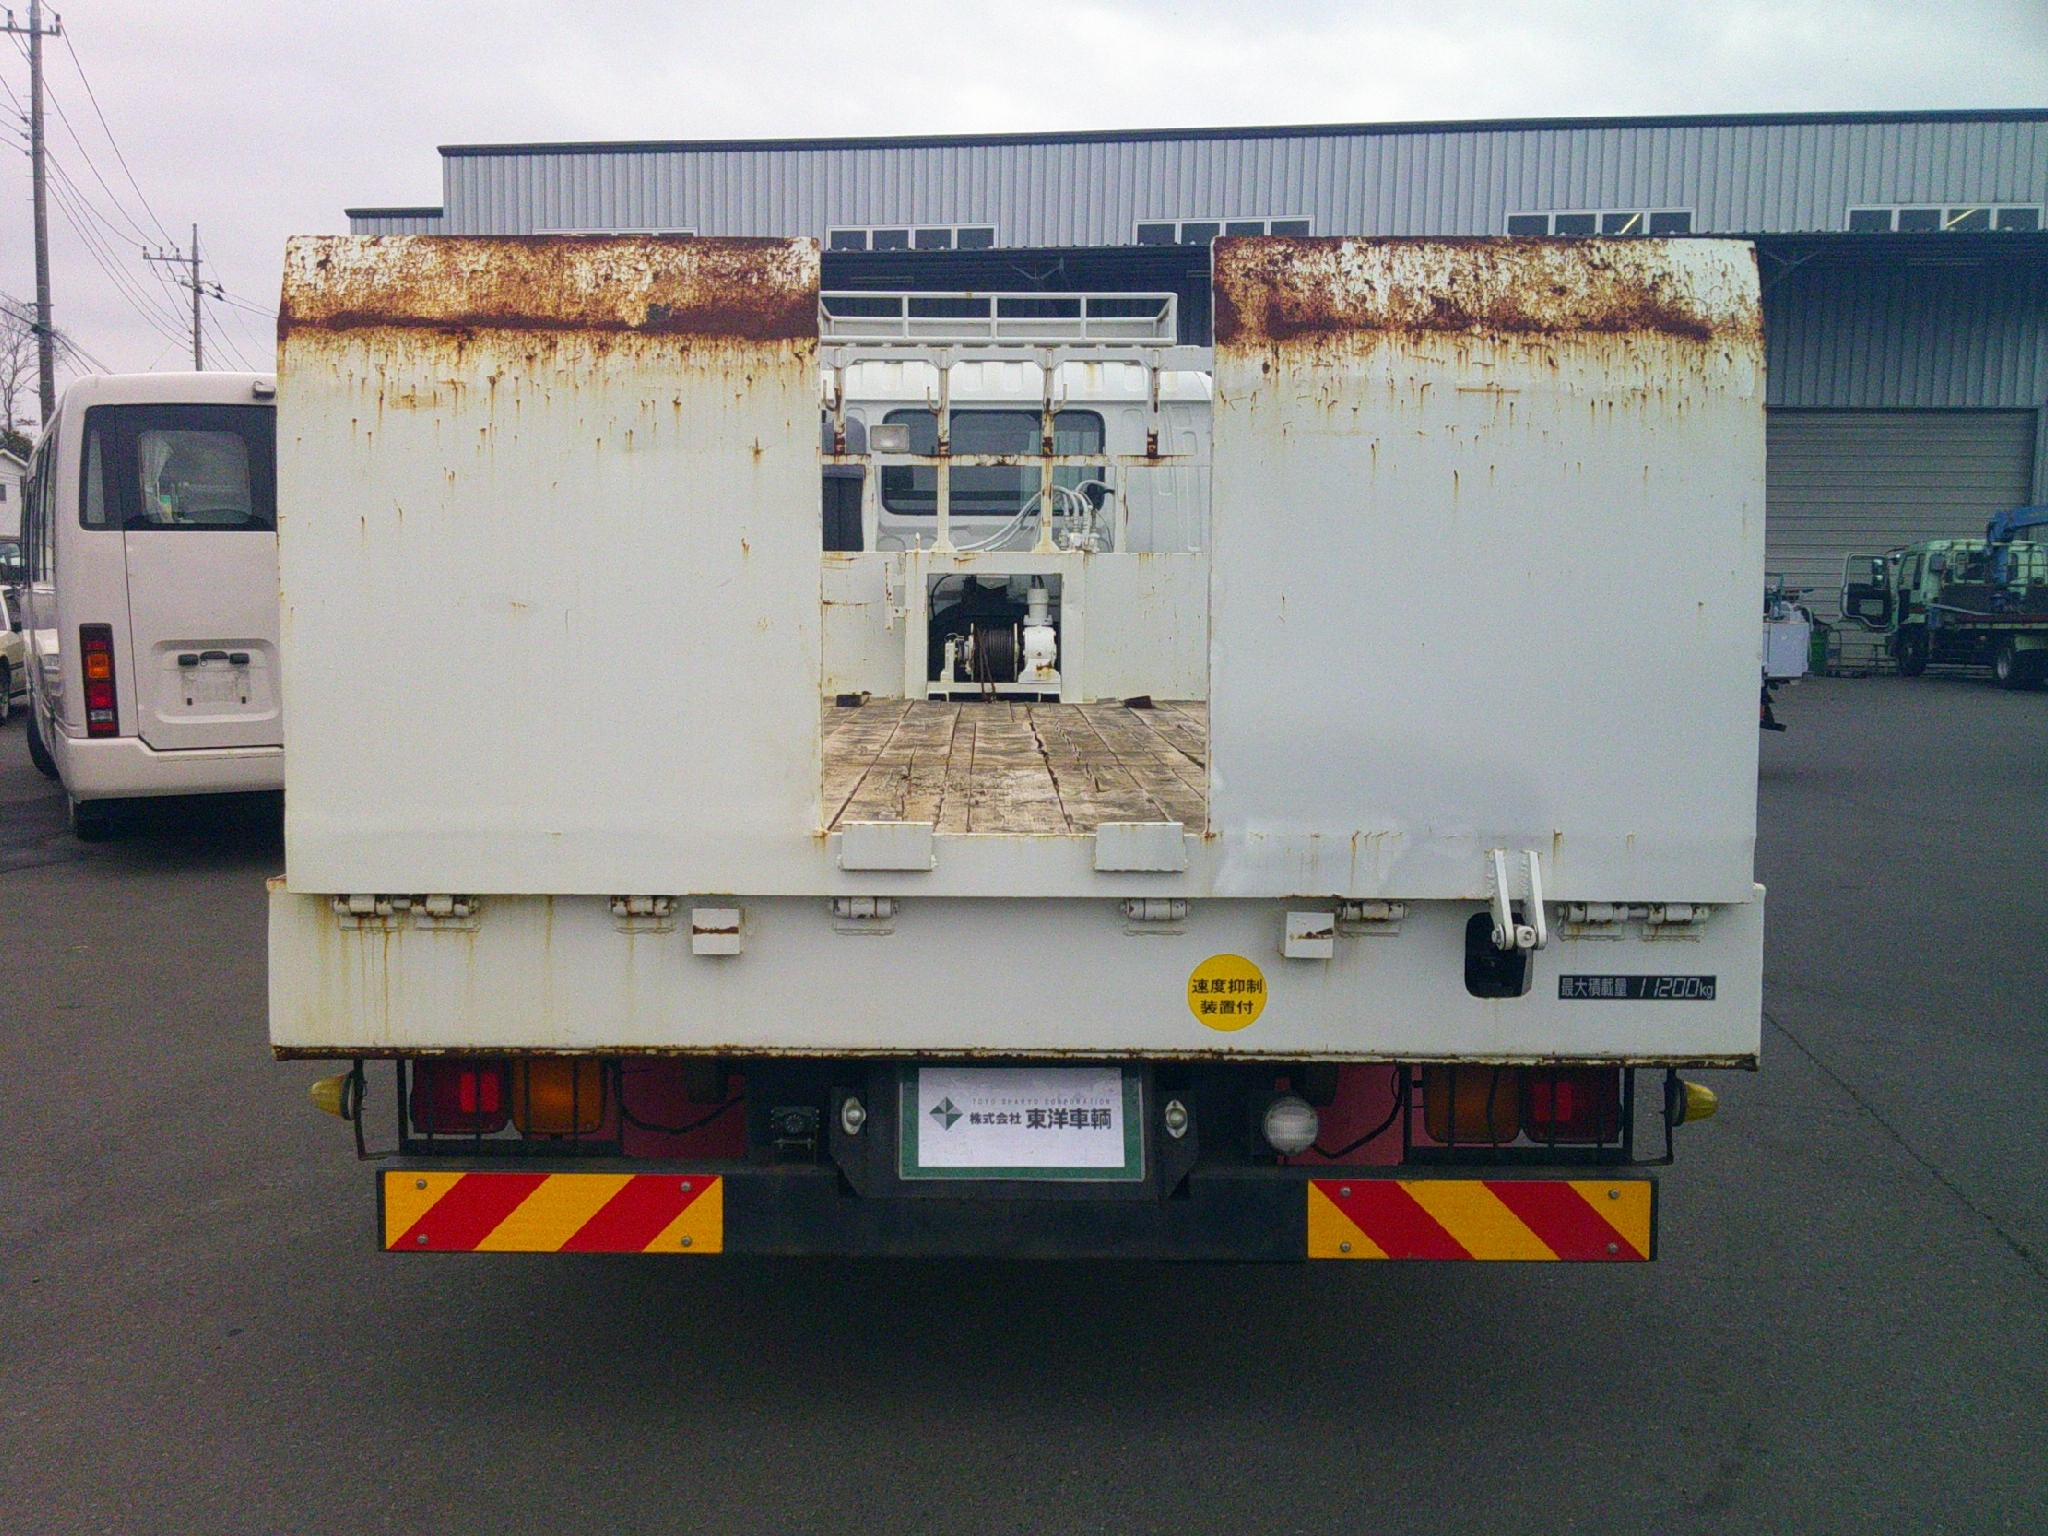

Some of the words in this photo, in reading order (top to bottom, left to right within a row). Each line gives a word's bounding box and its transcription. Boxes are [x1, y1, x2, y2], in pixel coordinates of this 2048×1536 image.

[1192, 979, 1262, 995] 速度抑制
[1561, 977, 1627, 997] 最大積載量
[1200, 1000, 1253, 1014] 装置付
[970, 1112, 1022, 1125] 株式会社
